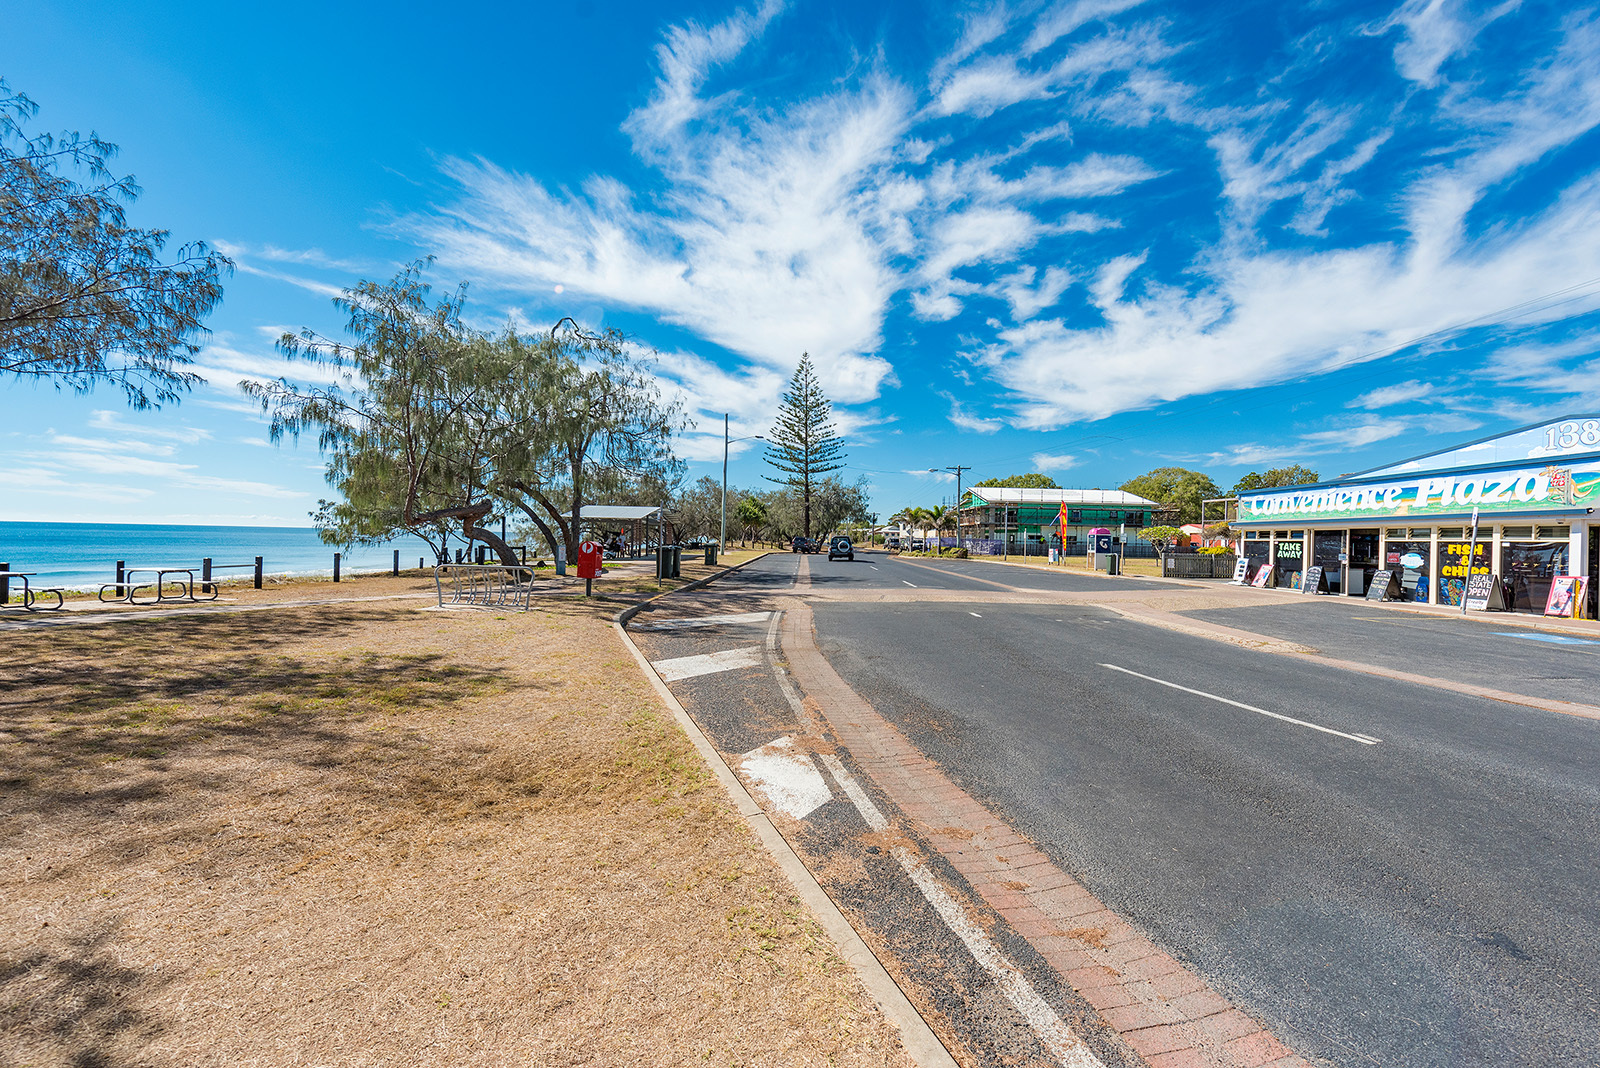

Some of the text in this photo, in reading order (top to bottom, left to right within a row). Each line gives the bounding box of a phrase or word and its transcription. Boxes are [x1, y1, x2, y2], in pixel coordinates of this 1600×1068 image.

[1545, 420, 1600, 451] 138
[1250, 470, 1550, 516] Convenience Plaza
[1278, 542, 1301, 551] TAKE
[1447, 544, 1483, 555] FISH
[1277, 550, 1302, 558] AWAY
[1460, 555, 1469, 565] &
[1441, 565, 1490, 577] CHIPS
[1473, 575, 1491, 583] REAL
[1468, 580, 1492, 589] STATE
